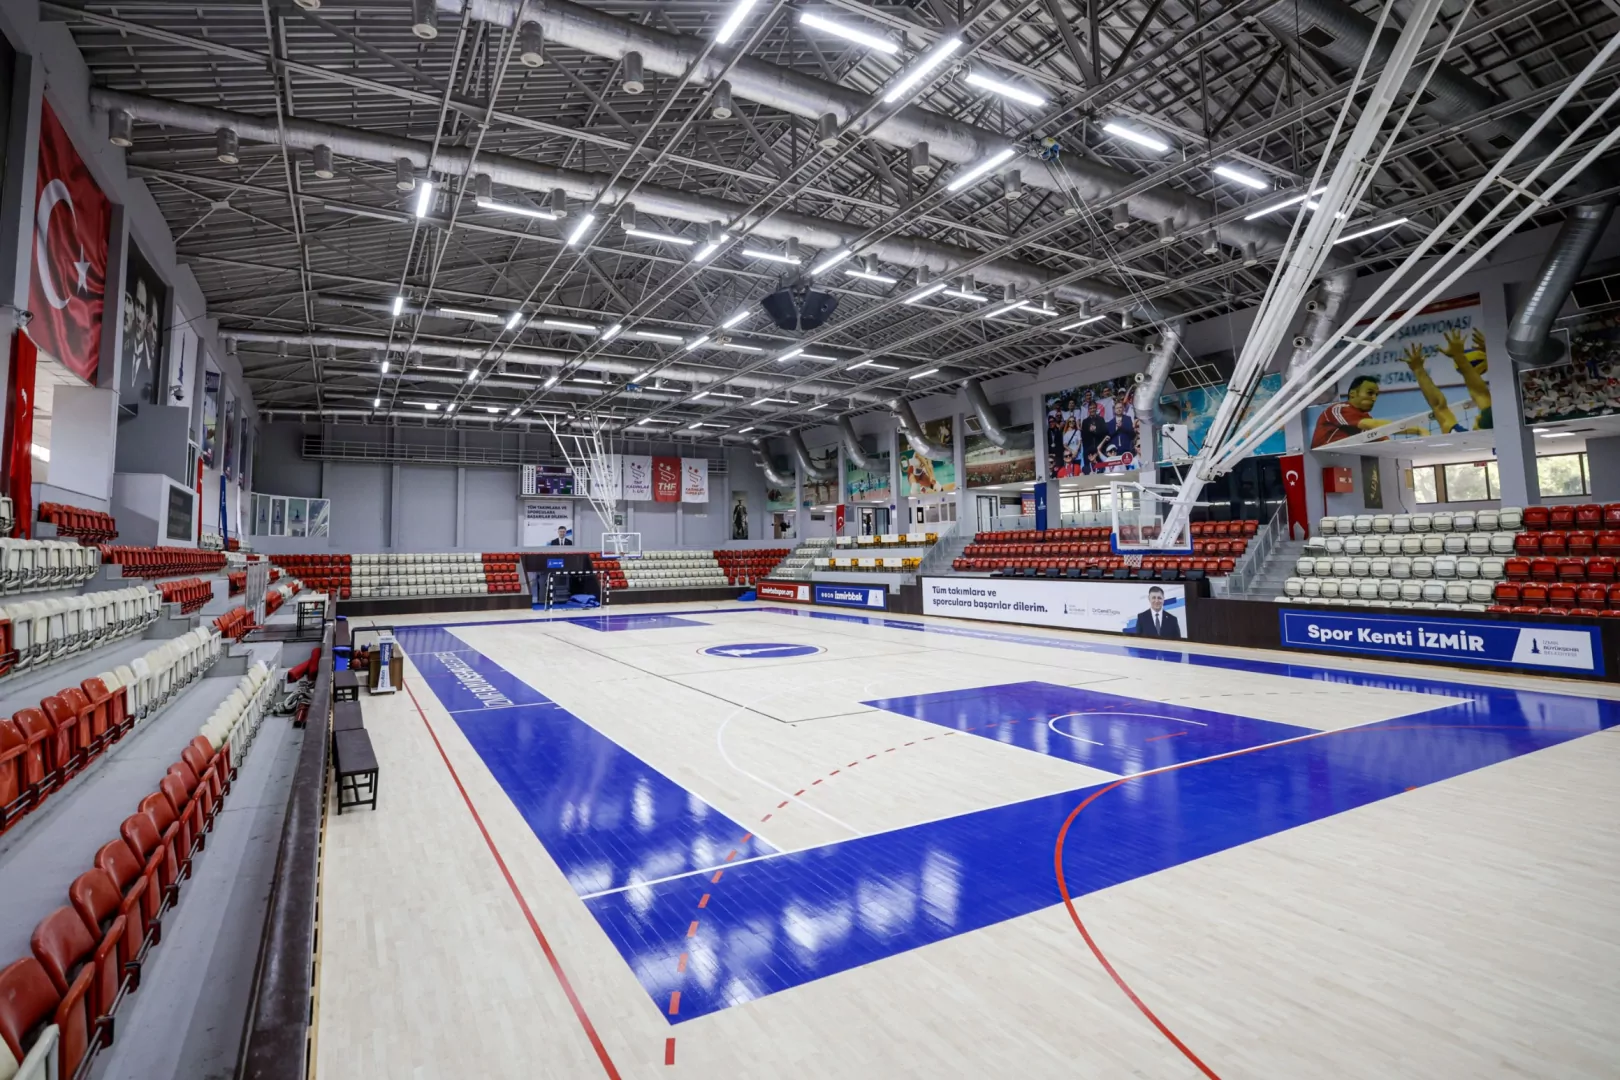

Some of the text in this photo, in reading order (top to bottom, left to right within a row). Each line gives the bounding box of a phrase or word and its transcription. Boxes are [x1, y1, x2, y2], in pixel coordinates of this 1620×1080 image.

[658, 482, 676, 490] THF
[932, 586, 947, 594] Tüm
[948, 587, 986, 596] takımlara
[933, 598, 1048, 612] sporculara başarılar dilerim.
[1308, 624, 1485, 652] Spor Kenti İZMİR
